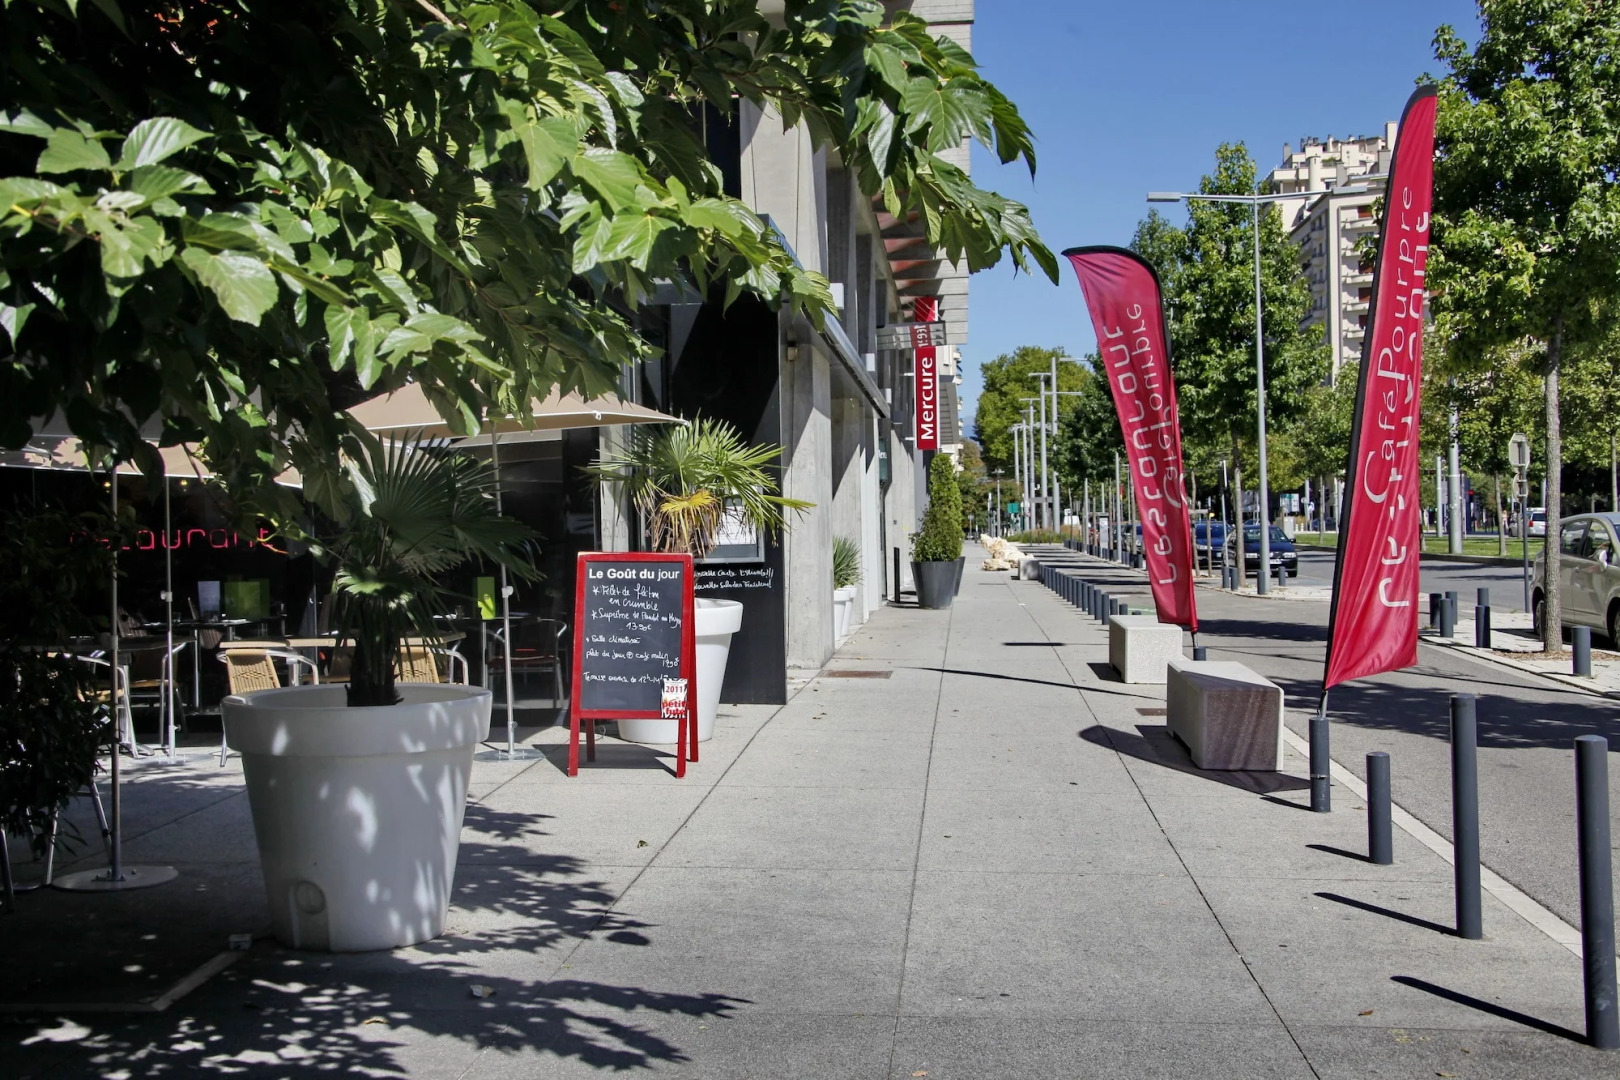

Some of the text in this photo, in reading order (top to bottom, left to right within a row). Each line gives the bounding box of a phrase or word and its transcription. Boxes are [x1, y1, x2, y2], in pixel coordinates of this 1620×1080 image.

[1364, 187, 1413, 503] Café Pourpre
[921, 357, 934, 440] Mercure
[589, 568, 680, 581] Le Goût du jour
[622, 586, 630, 596] de
[609, 597, 620, 606] en
